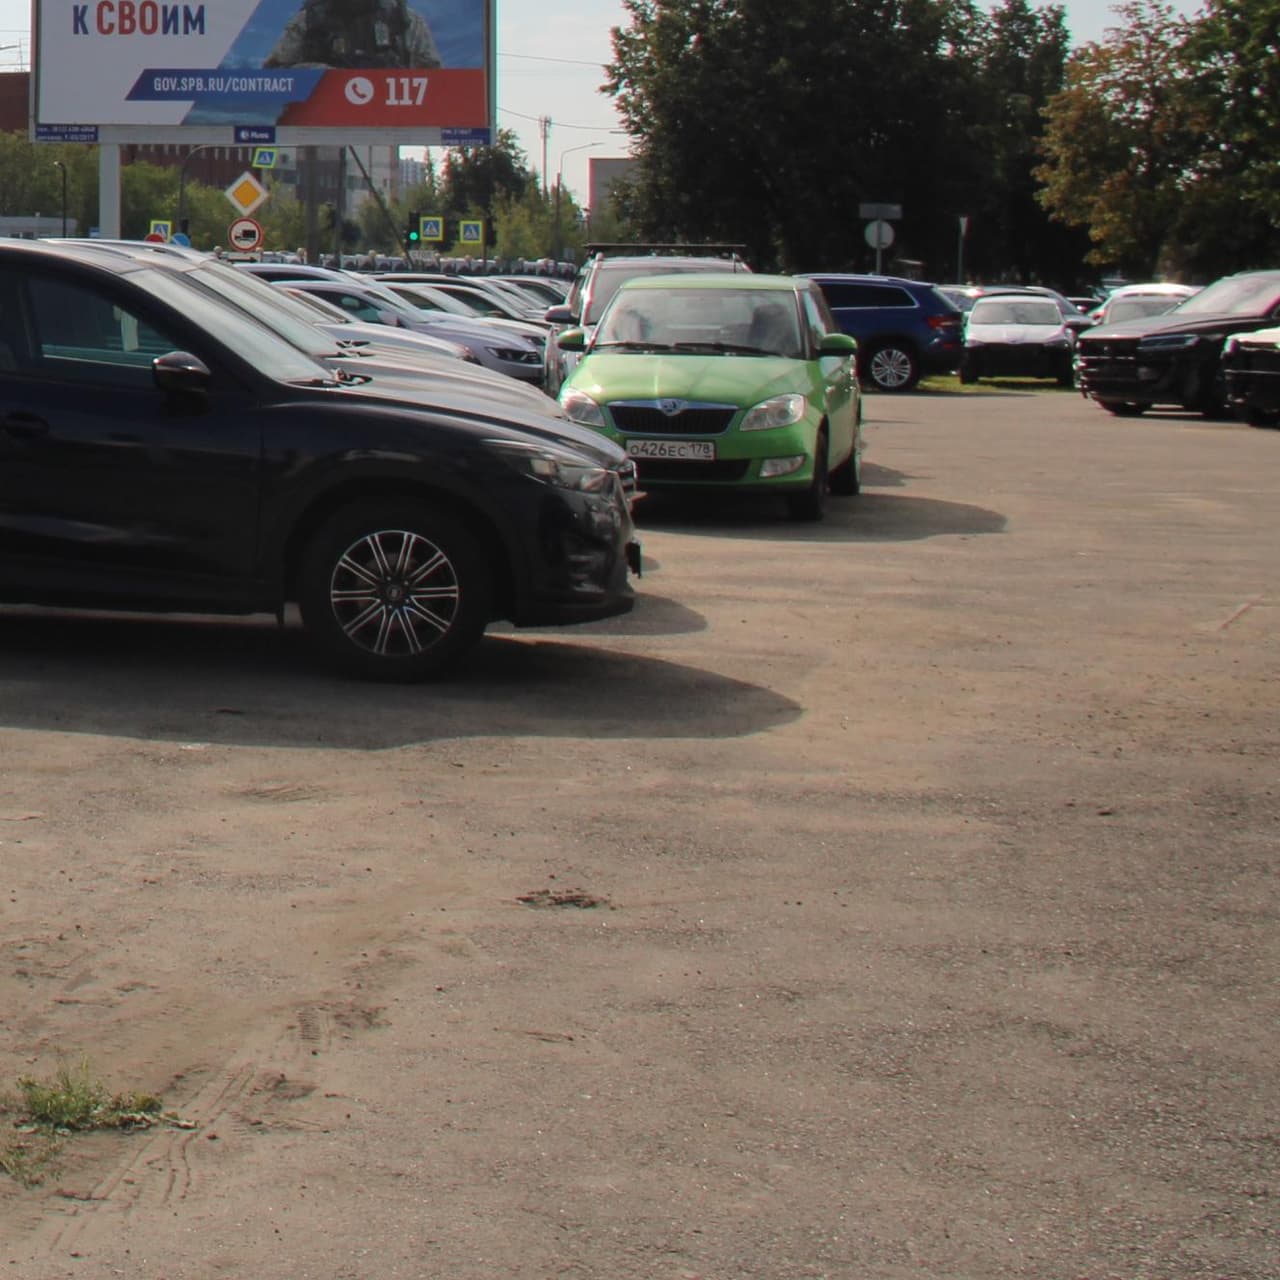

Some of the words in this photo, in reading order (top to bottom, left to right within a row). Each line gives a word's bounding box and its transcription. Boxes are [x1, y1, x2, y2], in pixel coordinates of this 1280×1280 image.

[72, 4, 90, 36] К
[153, 77, 294, 93] GOV.SPB.RU/CONTRACT
[385, 77, 429, 106] 117
